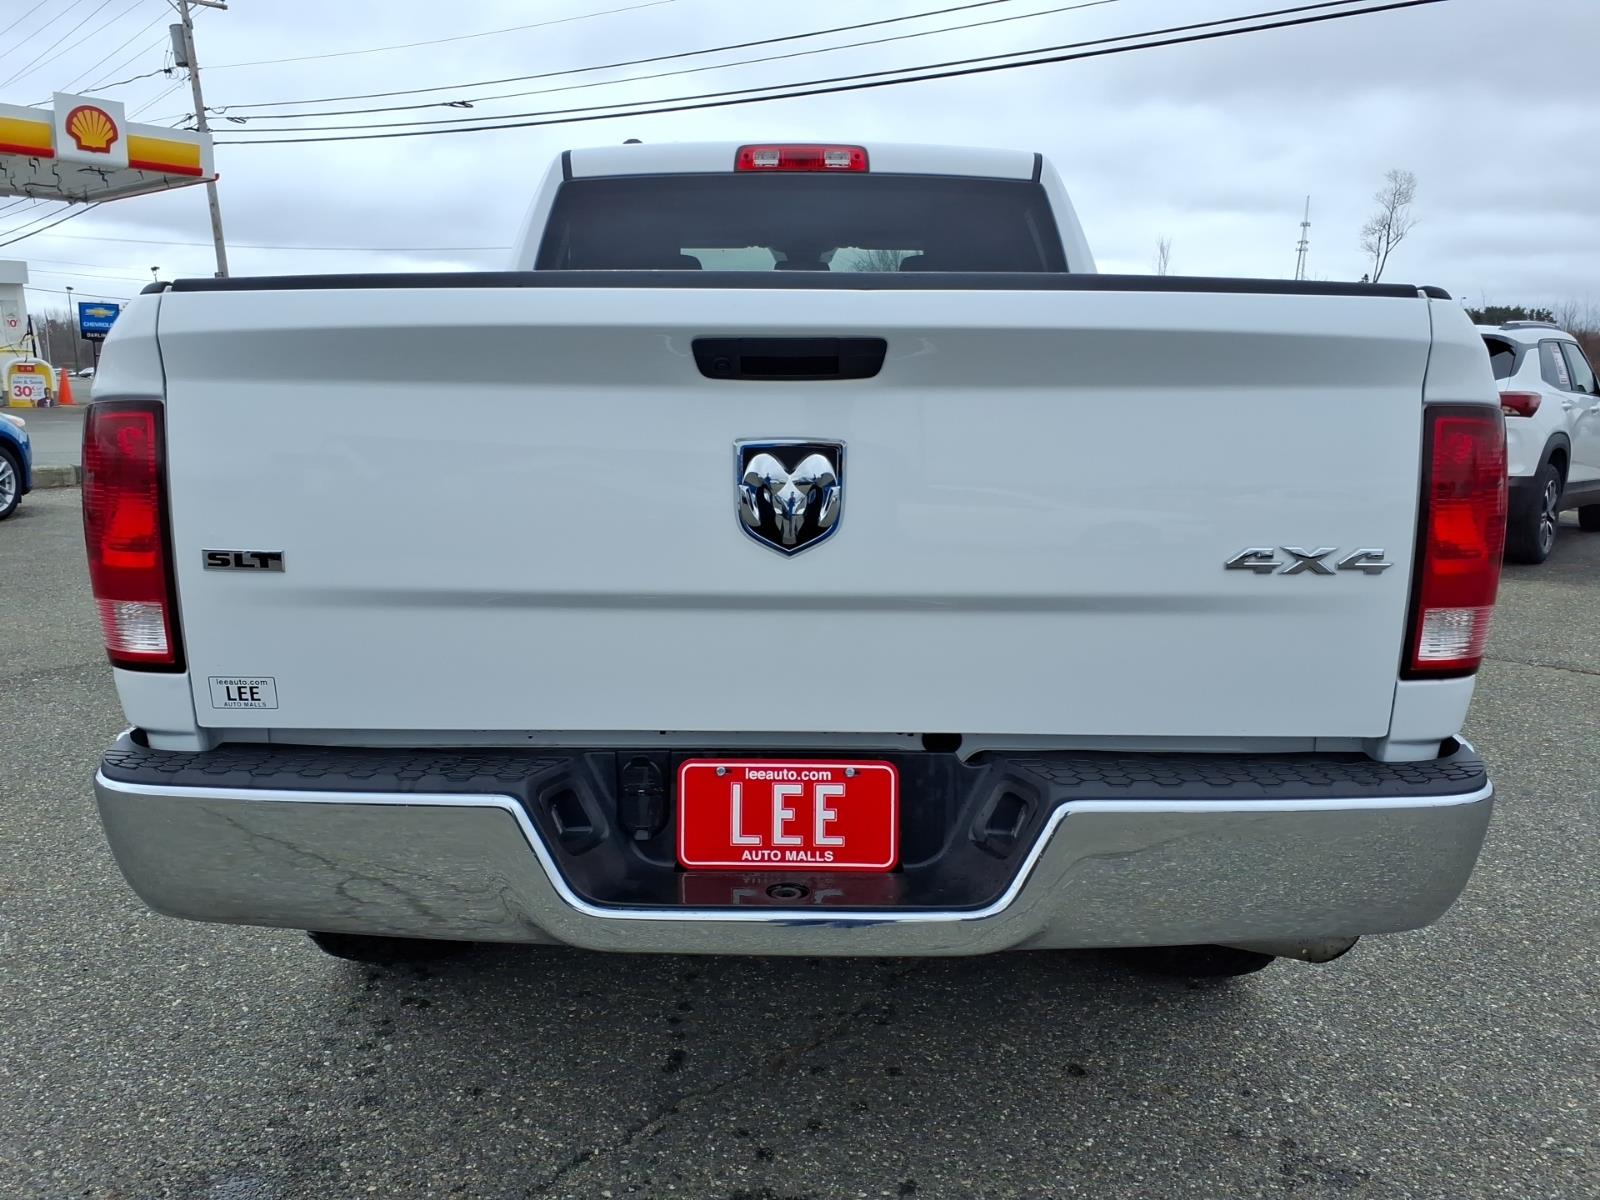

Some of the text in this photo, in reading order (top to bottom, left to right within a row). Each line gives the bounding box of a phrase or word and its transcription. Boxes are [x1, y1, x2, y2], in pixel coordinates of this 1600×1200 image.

[207, 551, 282, 569] SLT
[216, 678, 268, 686] leeauto.com
[226, 686, 262, 701] LEE
[745, 767, 832, 781] leeauto.com
[730, 782, 846, 848] LEE
[741, 850, 834, 862] AUTO MALLS
